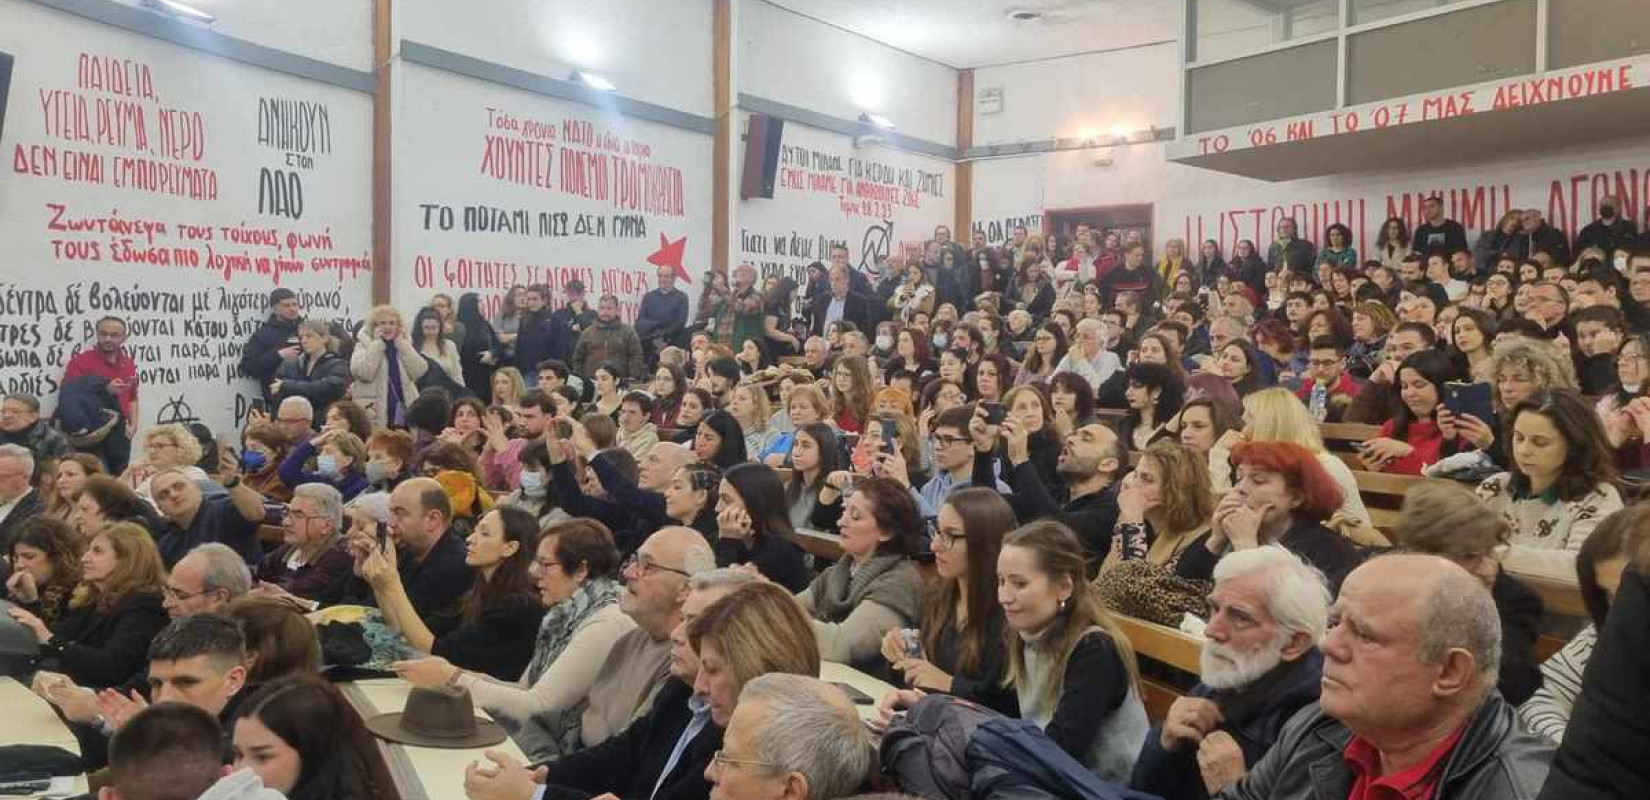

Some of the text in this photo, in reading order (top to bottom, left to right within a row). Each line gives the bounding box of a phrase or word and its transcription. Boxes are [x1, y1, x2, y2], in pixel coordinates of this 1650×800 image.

[79, 52, 159, 103] ΠΑΙΔΕΙΑ,
[158, 108, 204, 162] ΝΕΡΟ
[258, 97, 331, 156] ΑΝΗΚΟΥΝ
[562, 119, 594, 147] ΝΑΤΟ
[1199, 134, 1229, 157] ΤΟ
[1287, 119, 1314, 143] ΚΑΙ
[1330, 111, 1359, 135] ΤΟ
[1423, 90, 1475, 122] ΜΑΣ
[1493, 64, 1633, 112] ΔΕΙΧΝΟΥΝΕ
[13, 143, 218, 201] ΔΕΝ ΕΙΝΑΙ ΕΜΠΟΡΕΥΜΑΤΑ
[481, 133, 554, 189] ΧΟΥΝΤΕΣ
[258, 166, 304, 220] ΛΑΟ
[419, 203, 454, 231] ΤΟ
[463, 205, 530, 235] ΠΟΤΑΜΙ
[538, 211, 569, 238] ΠΙΣΩ
[574, 212, 606, 238] ΔΕΝ
[414, 254, 433, 289] ΟΙ
